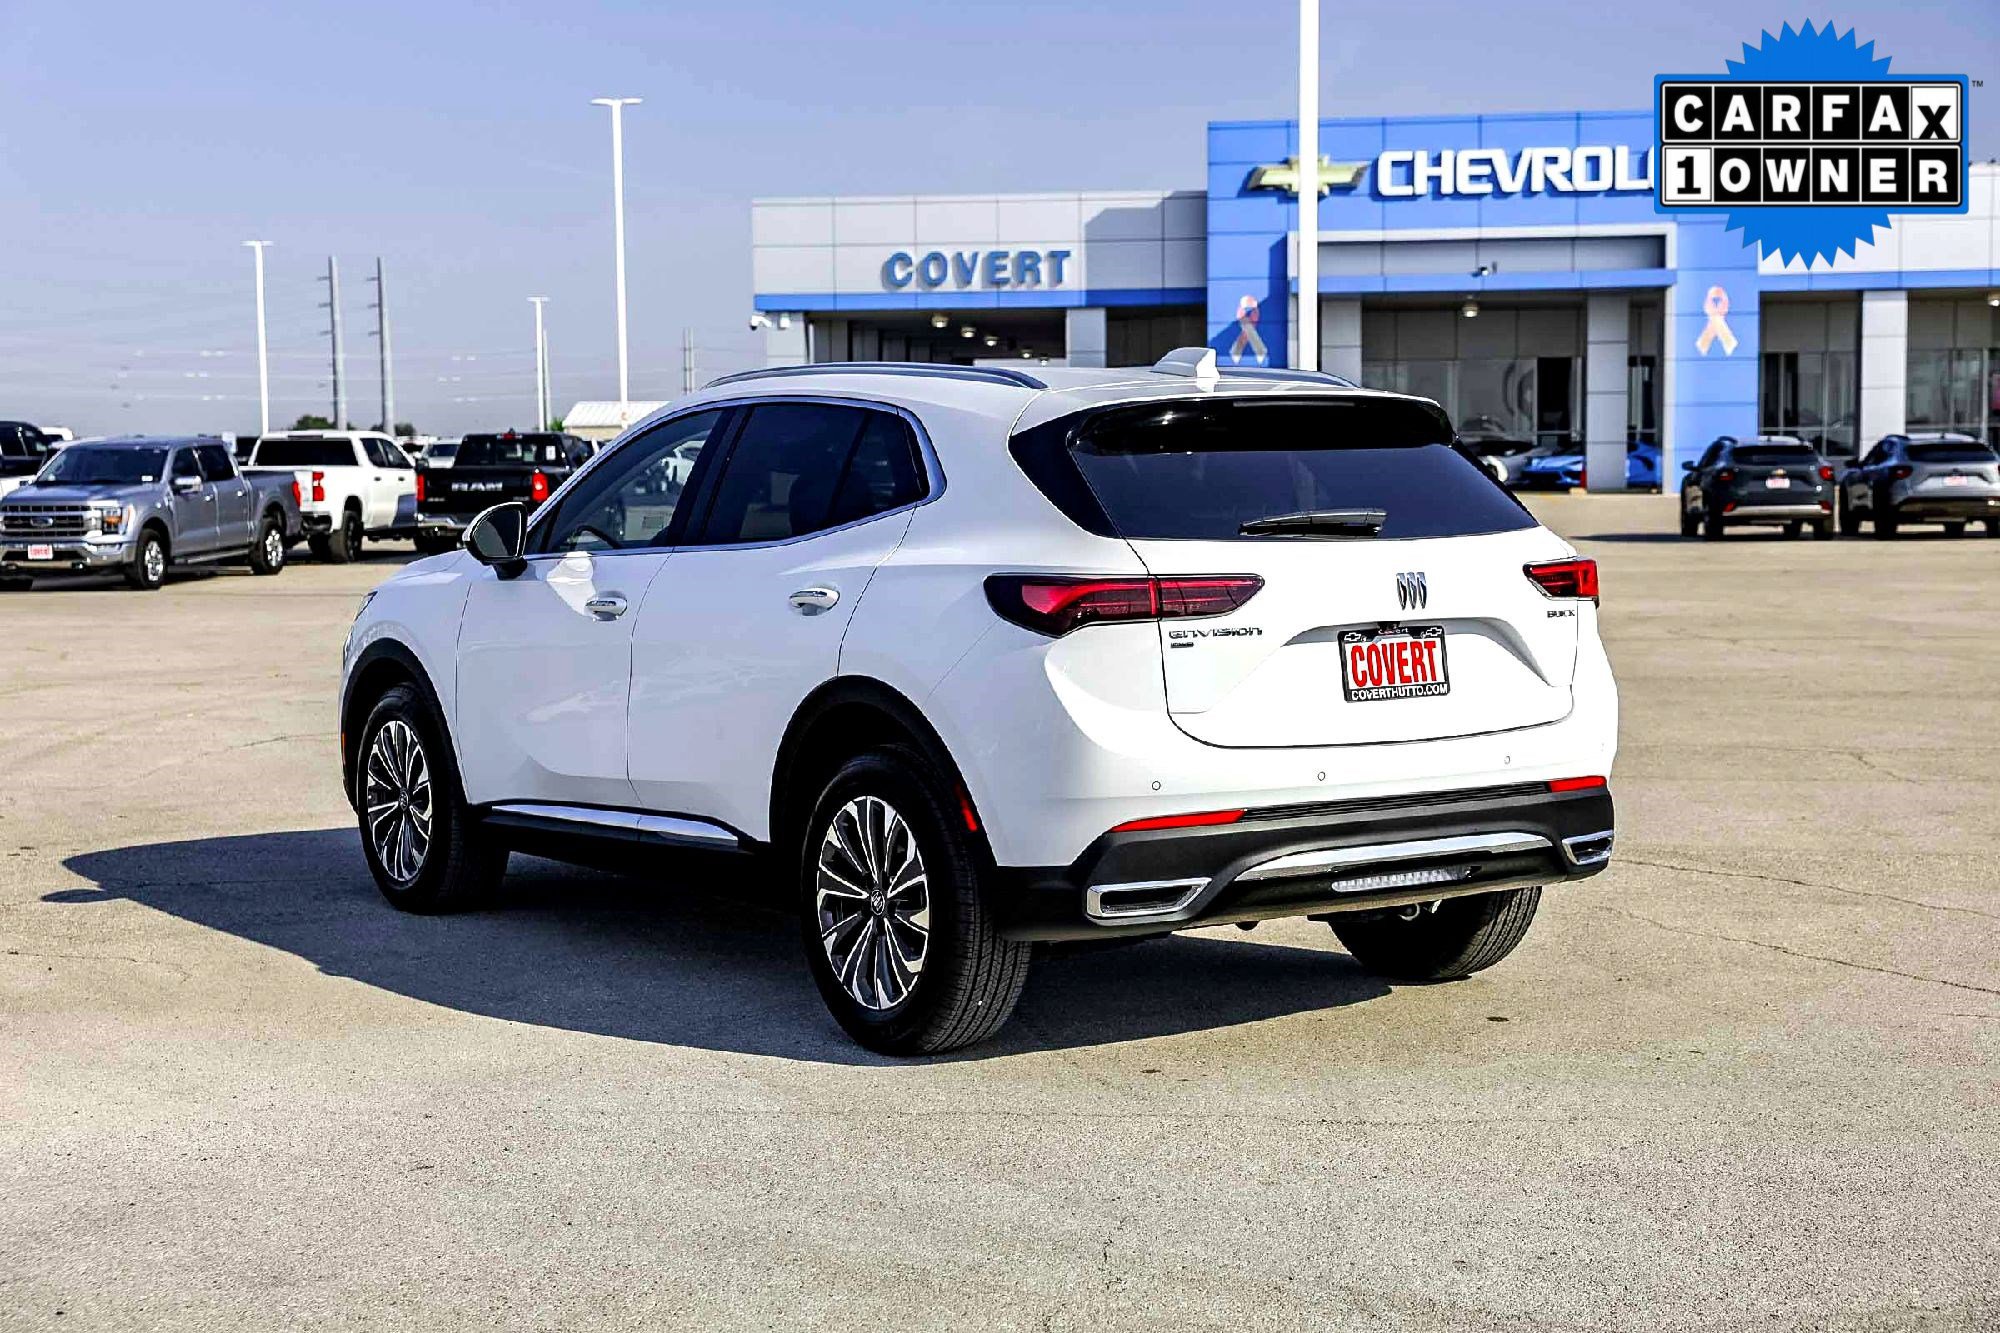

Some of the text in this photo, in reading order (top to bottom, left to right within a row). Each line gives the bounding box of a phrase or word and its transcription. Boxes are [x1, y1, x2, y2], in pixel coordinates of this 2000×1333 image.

[1377, 145, 1654, 197] CHEVROL
[885, 250, 1071, 290] COVERT
[1351, 640, 1438, 687] COVERT
[1351, 683, 1448, 701] COVERTHUTTO.COM
